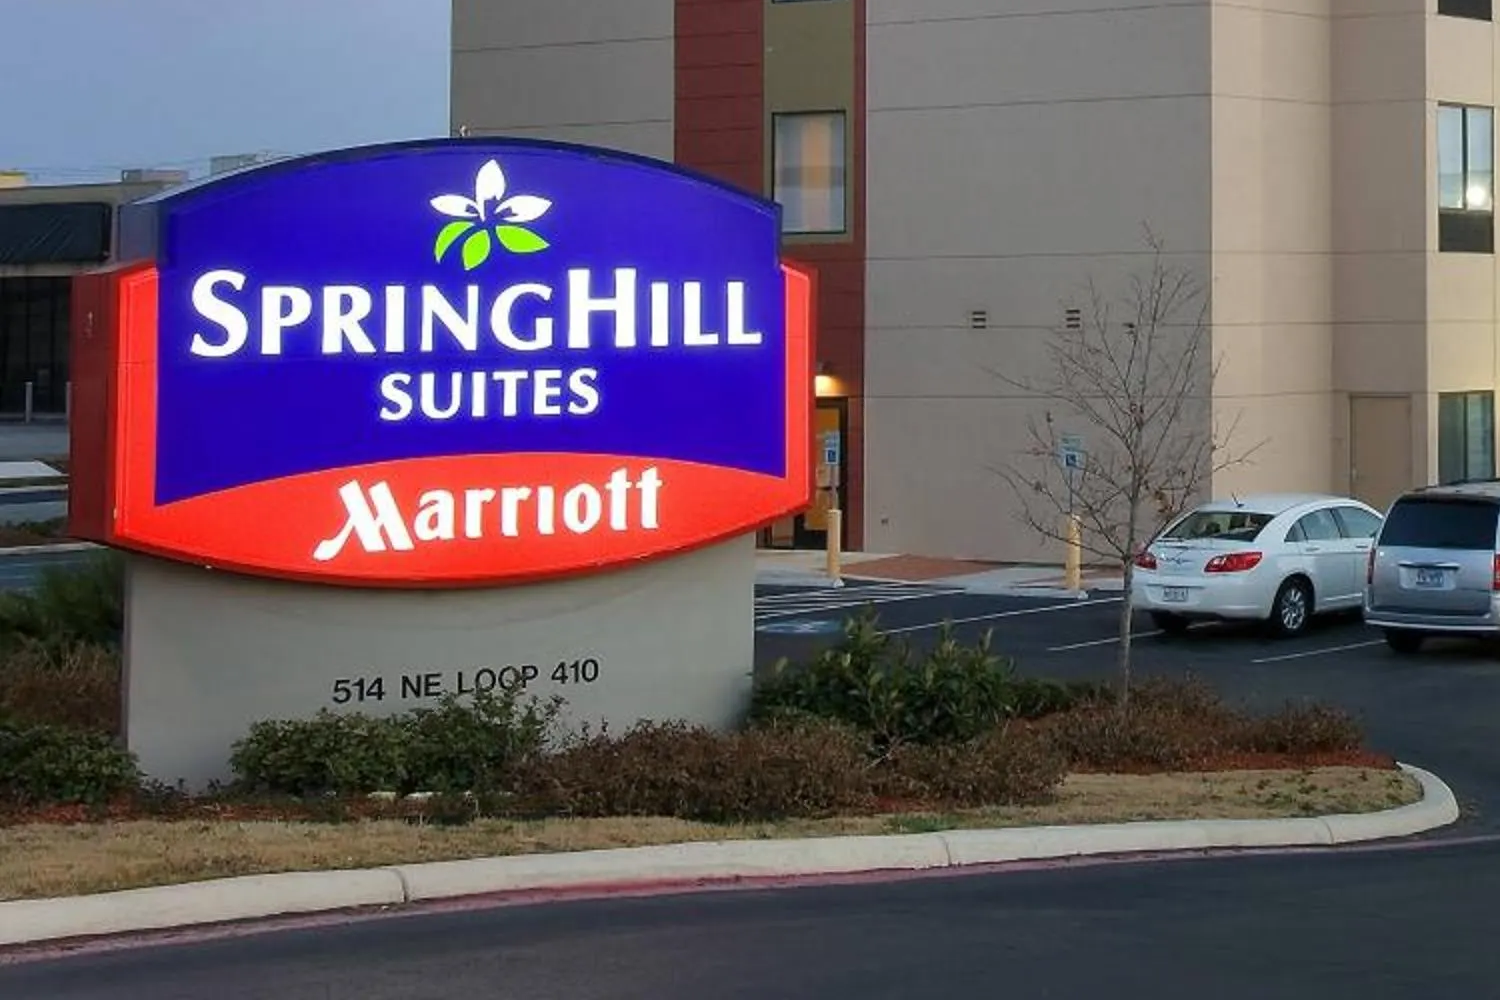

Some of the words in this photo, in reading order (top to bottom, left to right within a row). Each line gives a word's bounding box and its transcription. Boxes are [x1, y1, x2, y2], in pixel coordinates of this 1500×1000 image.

[189, 266, 763, 358] SPRINGHILL
[379, 367, 600, 421] SUITES
[312, 465, 663, 562] Marriott
[332, 677, 385, 705] 514
[401, 672, 443, 699] NE
[457, 665, 539, 697] LOOP
[551, 658, 600, 685] 410
